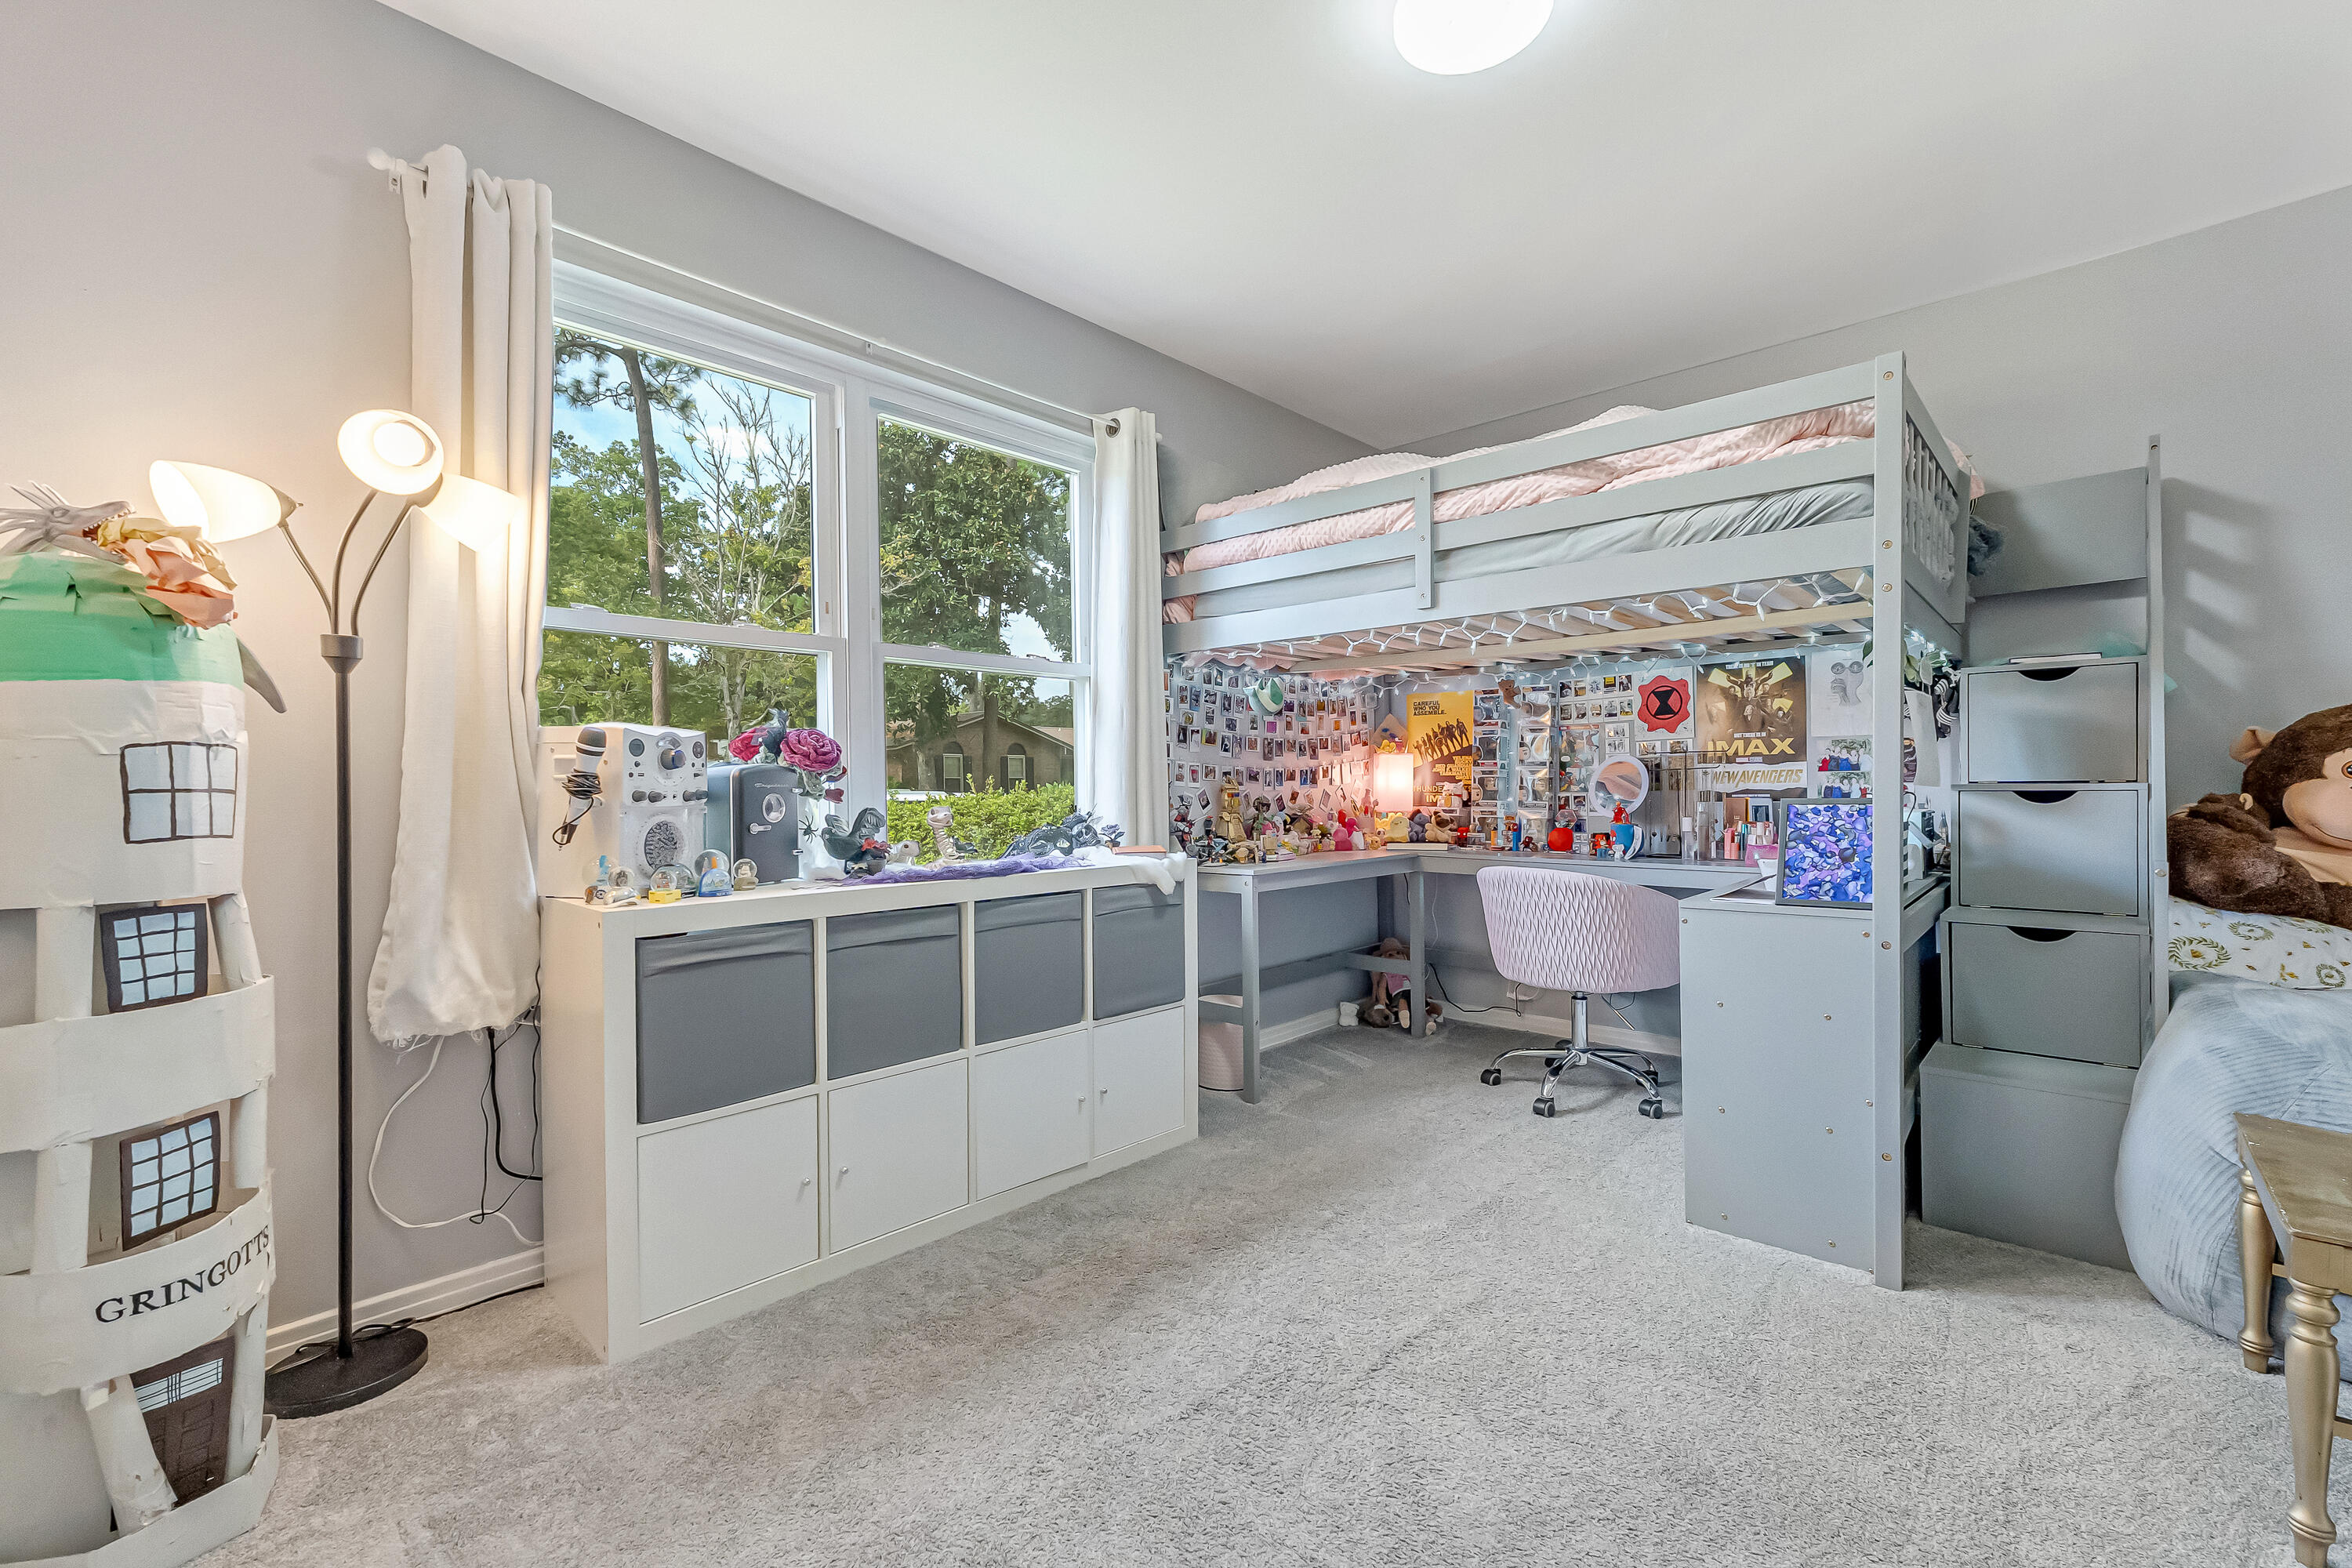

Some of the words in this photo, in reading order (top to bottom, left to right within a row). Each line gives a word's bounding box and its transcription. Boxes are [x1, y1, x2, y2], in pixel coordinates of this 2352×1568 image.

[1707, 737, 1796, 757] IMAX
[1713, 770, 1738, 785] NEW
[1734, 768, 1804, 788] AVENGERS
[95, 1225, 269, 1323] GRINGOTTS
